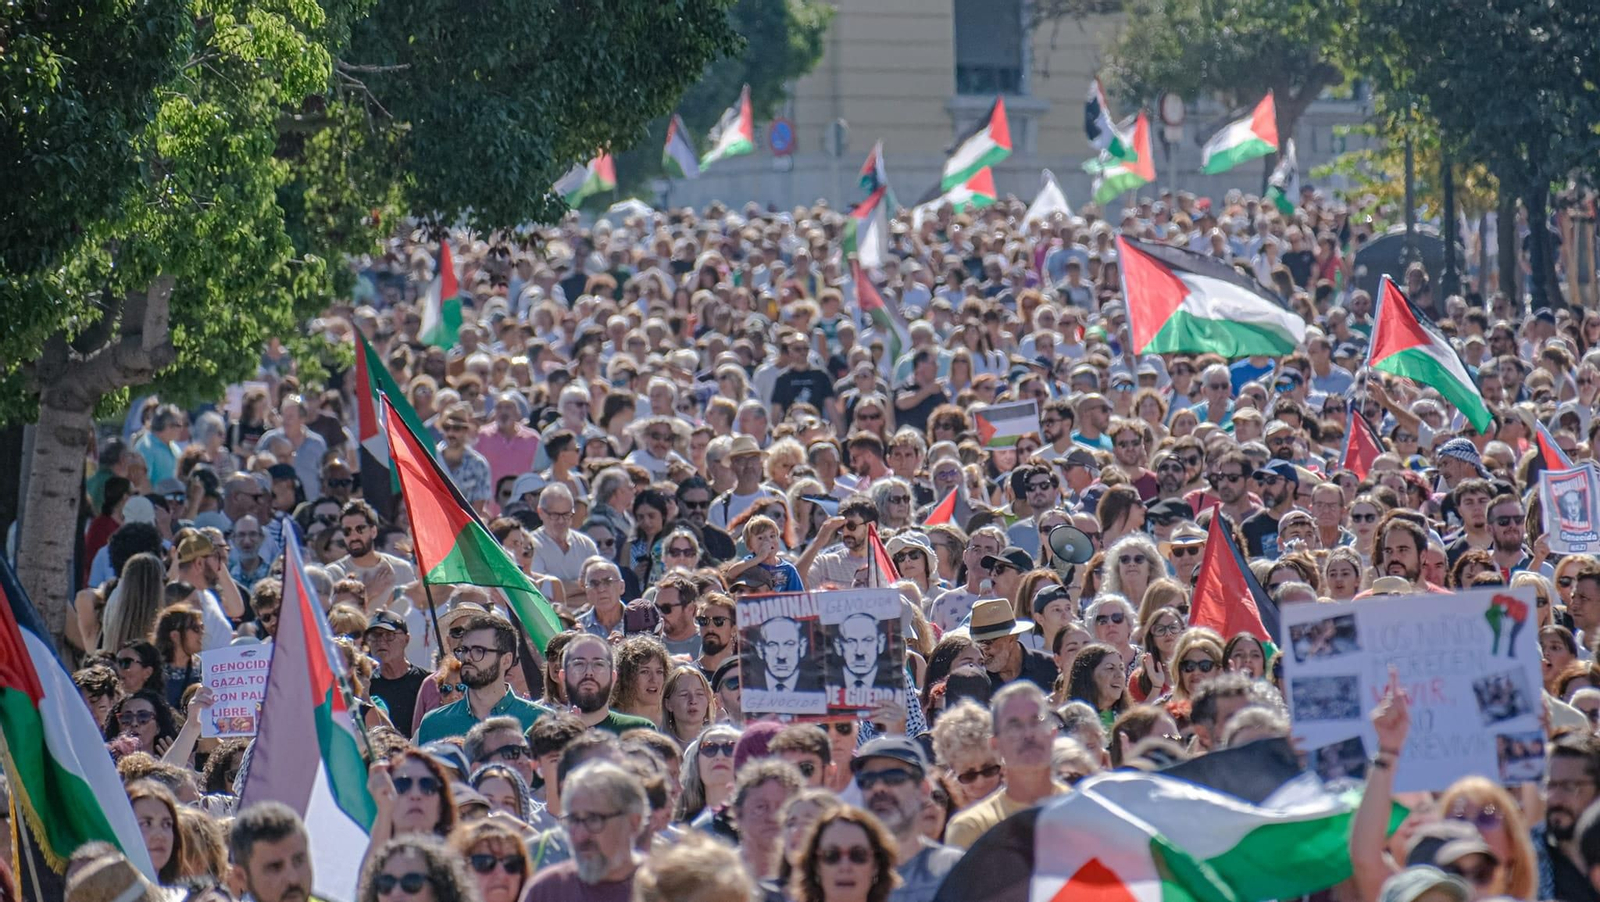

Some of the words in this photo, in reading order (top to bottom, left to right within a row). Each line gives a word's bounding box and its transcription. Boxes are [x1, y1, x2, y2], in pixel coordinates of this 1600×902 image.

[736, 593, 818, 630] CRIMINAL
[211, 660, 270, 673] GENOCID
[212, 692, 237, 703] CON
[212, 707, 251, 717] LIBRE.
